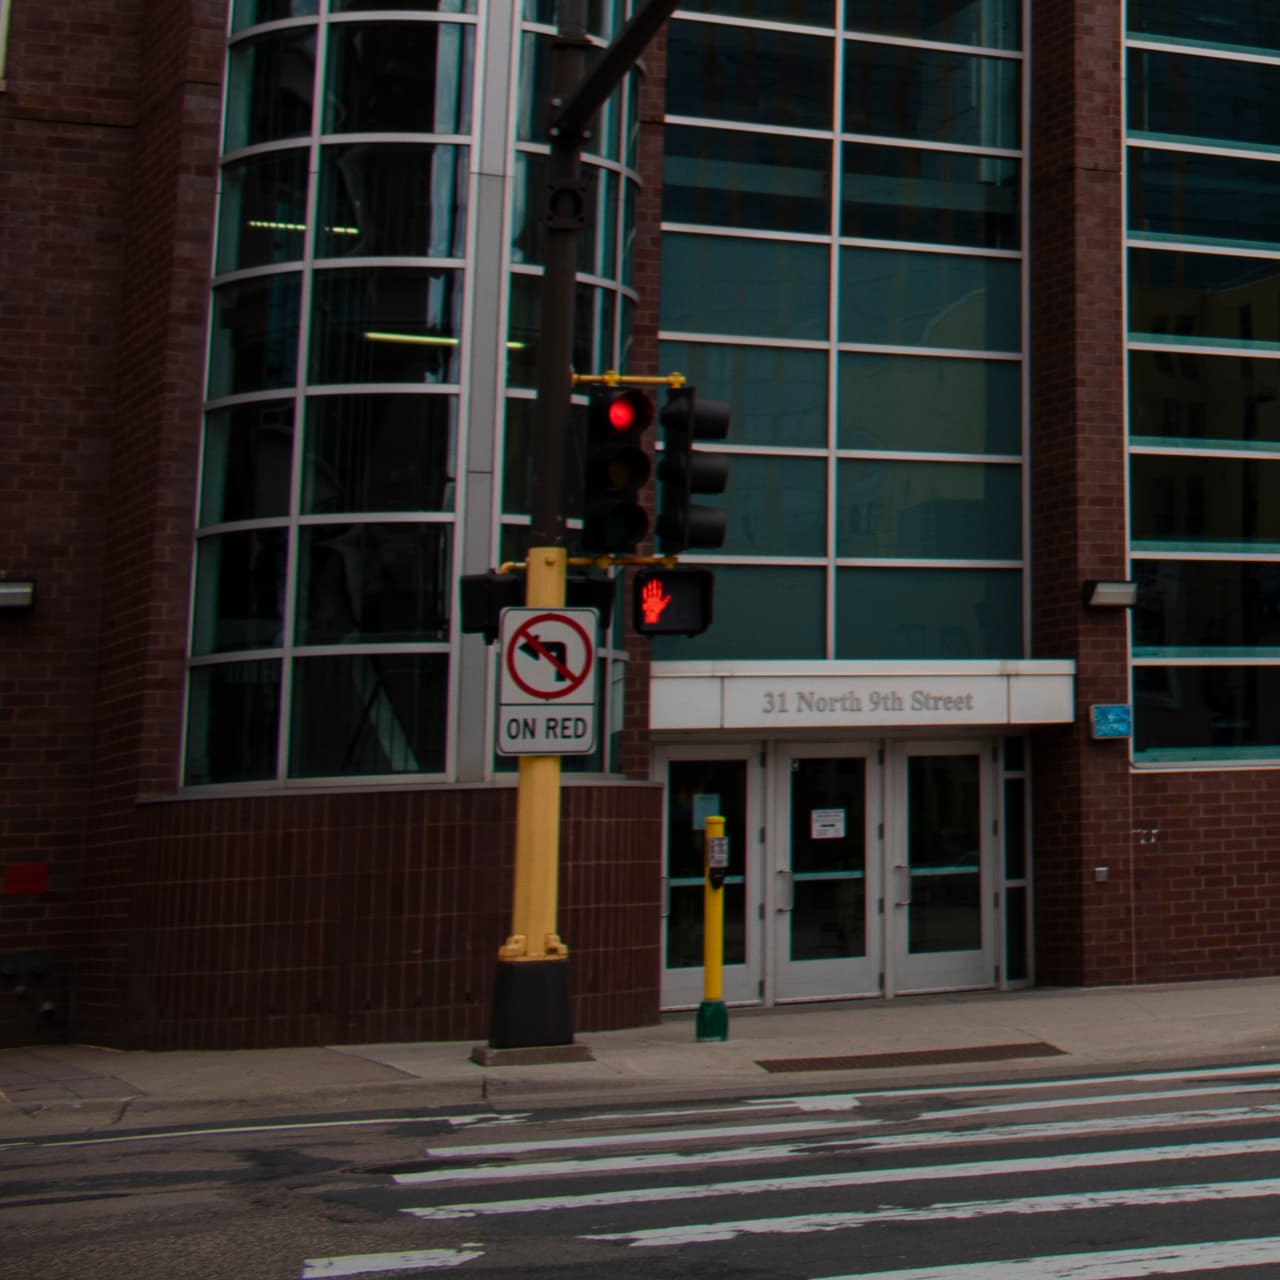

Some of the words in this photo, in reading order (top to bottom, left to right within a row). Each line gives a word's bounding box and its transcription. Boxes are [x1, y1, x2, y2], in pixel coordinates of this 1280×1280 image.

[762, 691, 789, 714] 31
[796, 690, 862, 713] North
[868, 690, 904, 712] 9th
[910, 689, 974, 712] Street
[507, 718, 536, 739] ON
[545, 718, 587, 739] RED
